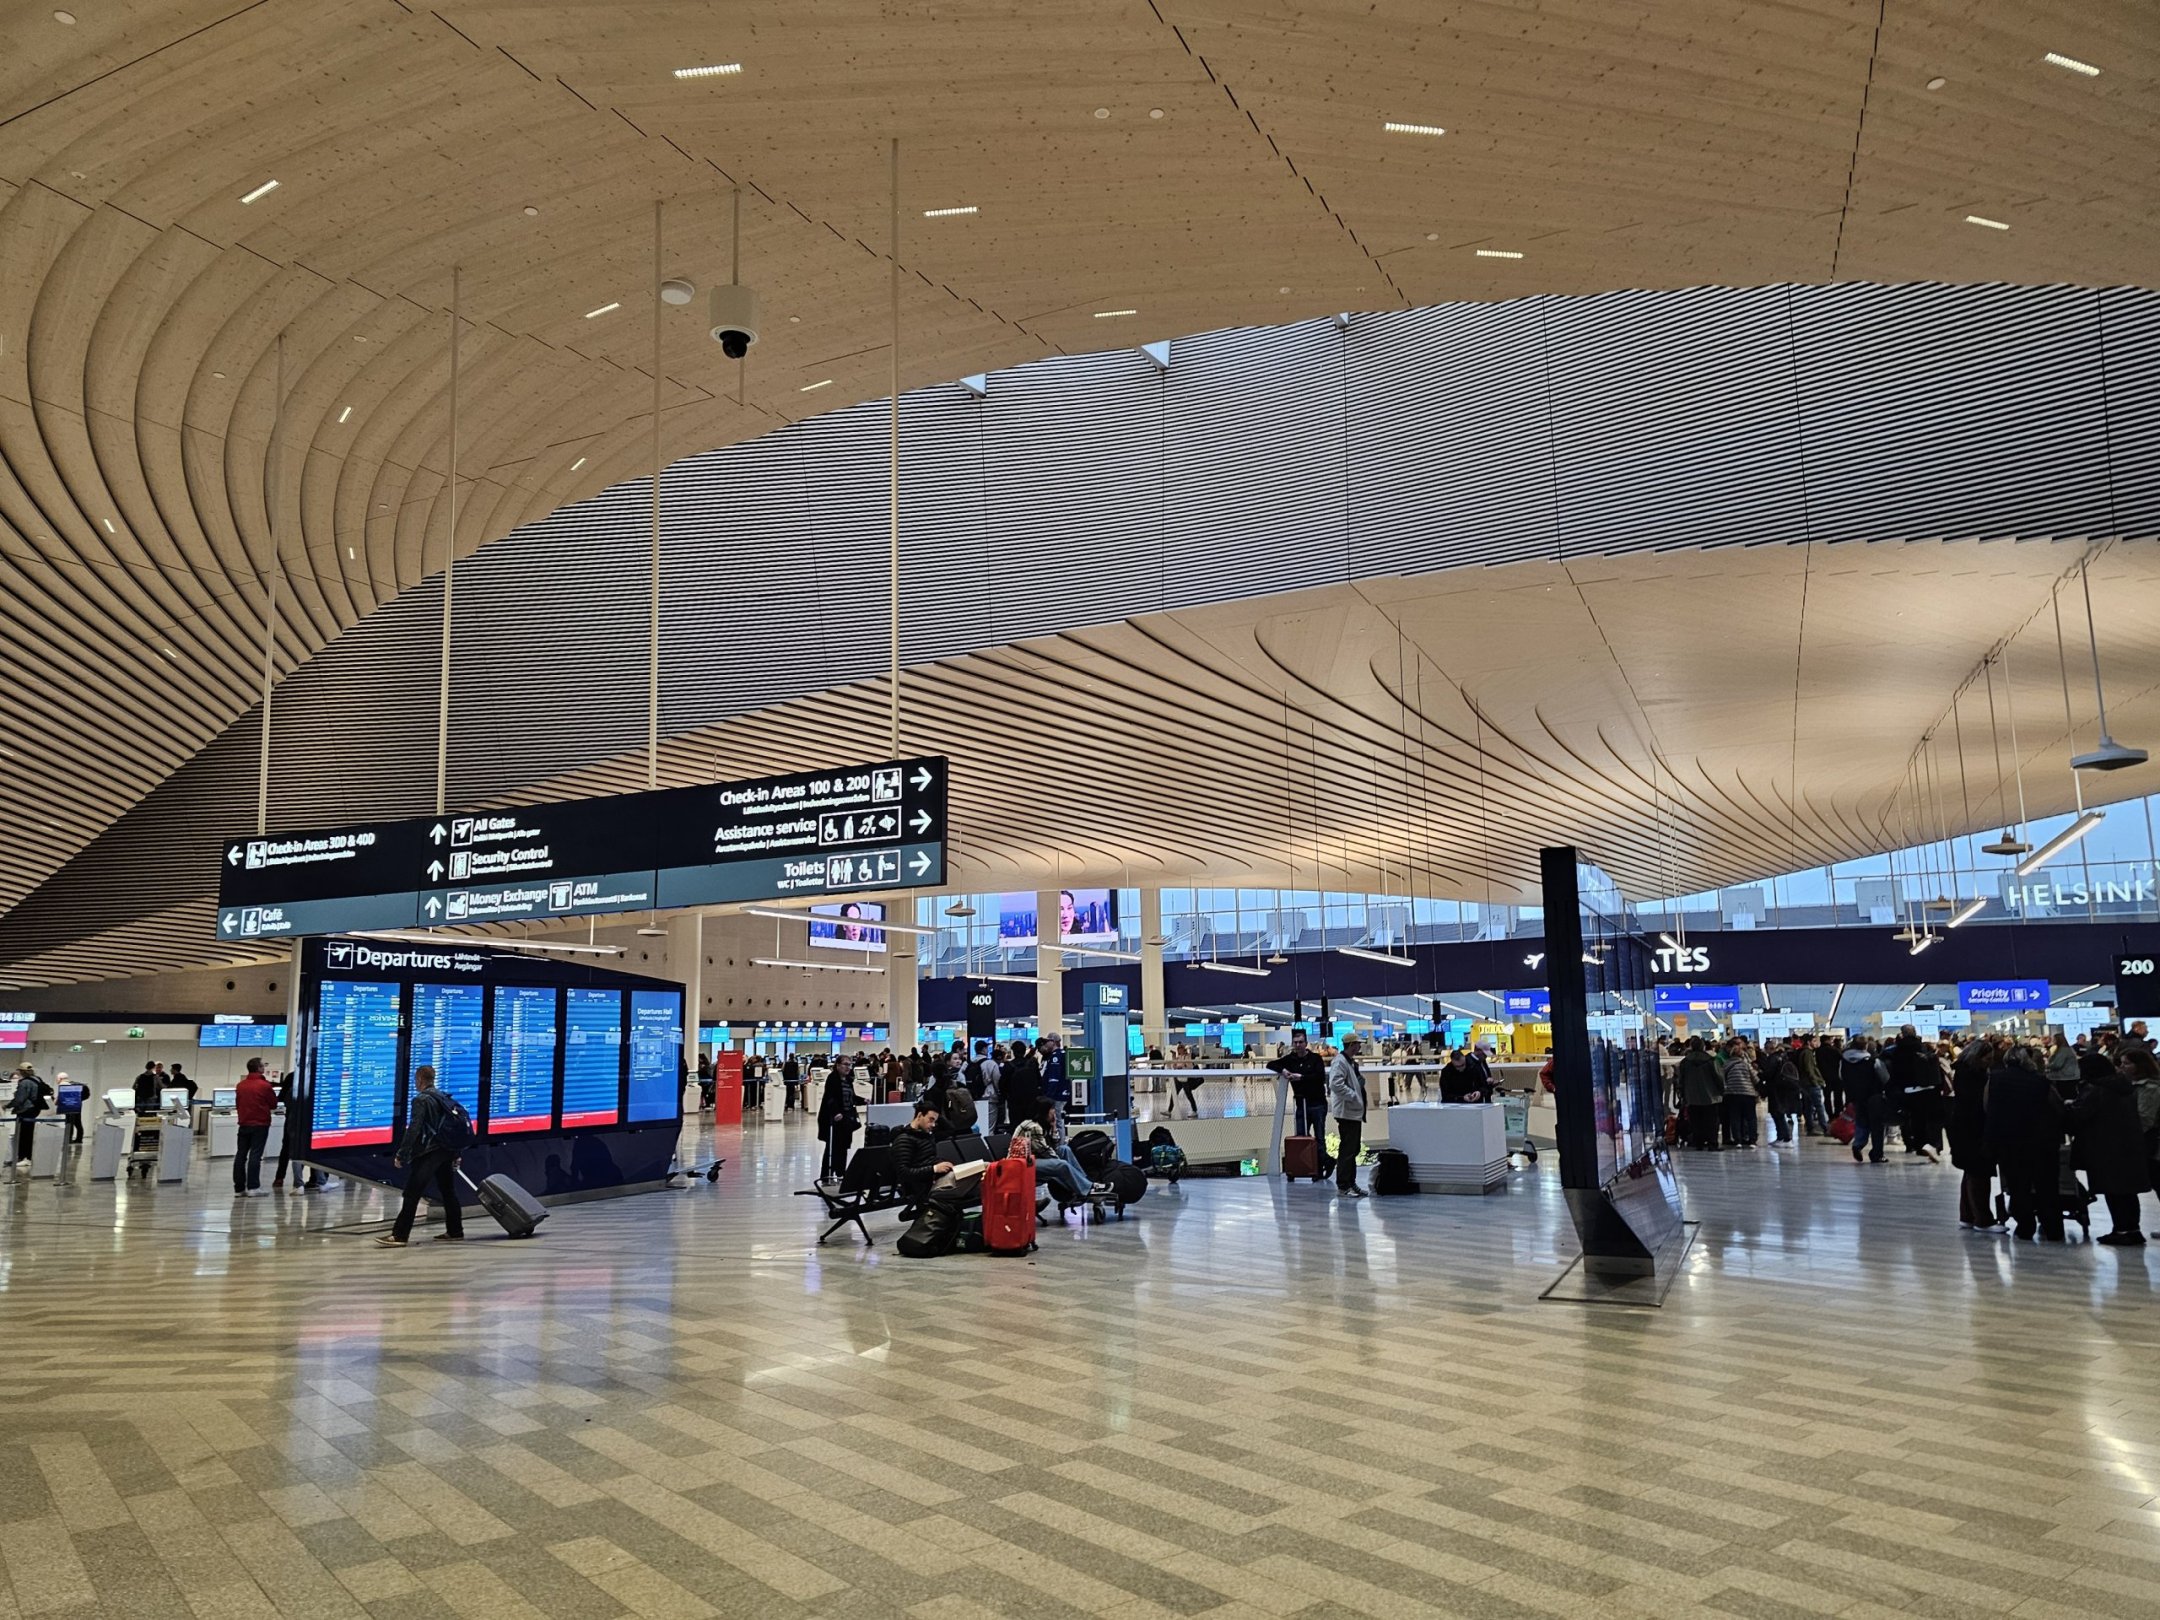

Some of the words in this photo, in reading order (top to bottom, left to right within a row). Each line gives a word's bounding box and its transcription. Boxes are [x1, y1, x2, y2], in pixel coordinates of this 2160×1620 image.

[720, 787, 769, 806] Check-in
[771, 785, 806, 800] Areas
[809, 780, 831, 795] 100
[833, 778, 844, 792] &
[846, 775, 870, 791] 200
[473, 818, 488, 832] All
[488, 817, 516, 831] Gates
[714, 825, 774, 842] Assistance
[775, 818, 817, 835] service
[267, 840, 303, 855] Check-in
[303, 839, 329, 852] Areas
[329, 835, 347, 849] 300
[347, 834, 356, 847] &
[356, 832, 376, 846] 400
[472, 851, 511, 866] Security
[511, 845, 549, 862] Control
[784, 861, 825, 877] Toilets
[573, 882, 598, 896] ATM
[777, 880, 790, 889] WC
[469, 892, 503, 906] Money
[503, 889, 549, 904] Exchange
[356, 946, 451, 971] Departures
[2120, 958, 2154, 975] 200
[971, 995, 992, 1006] 400
[1971, 987, 2009, 998] Priority
